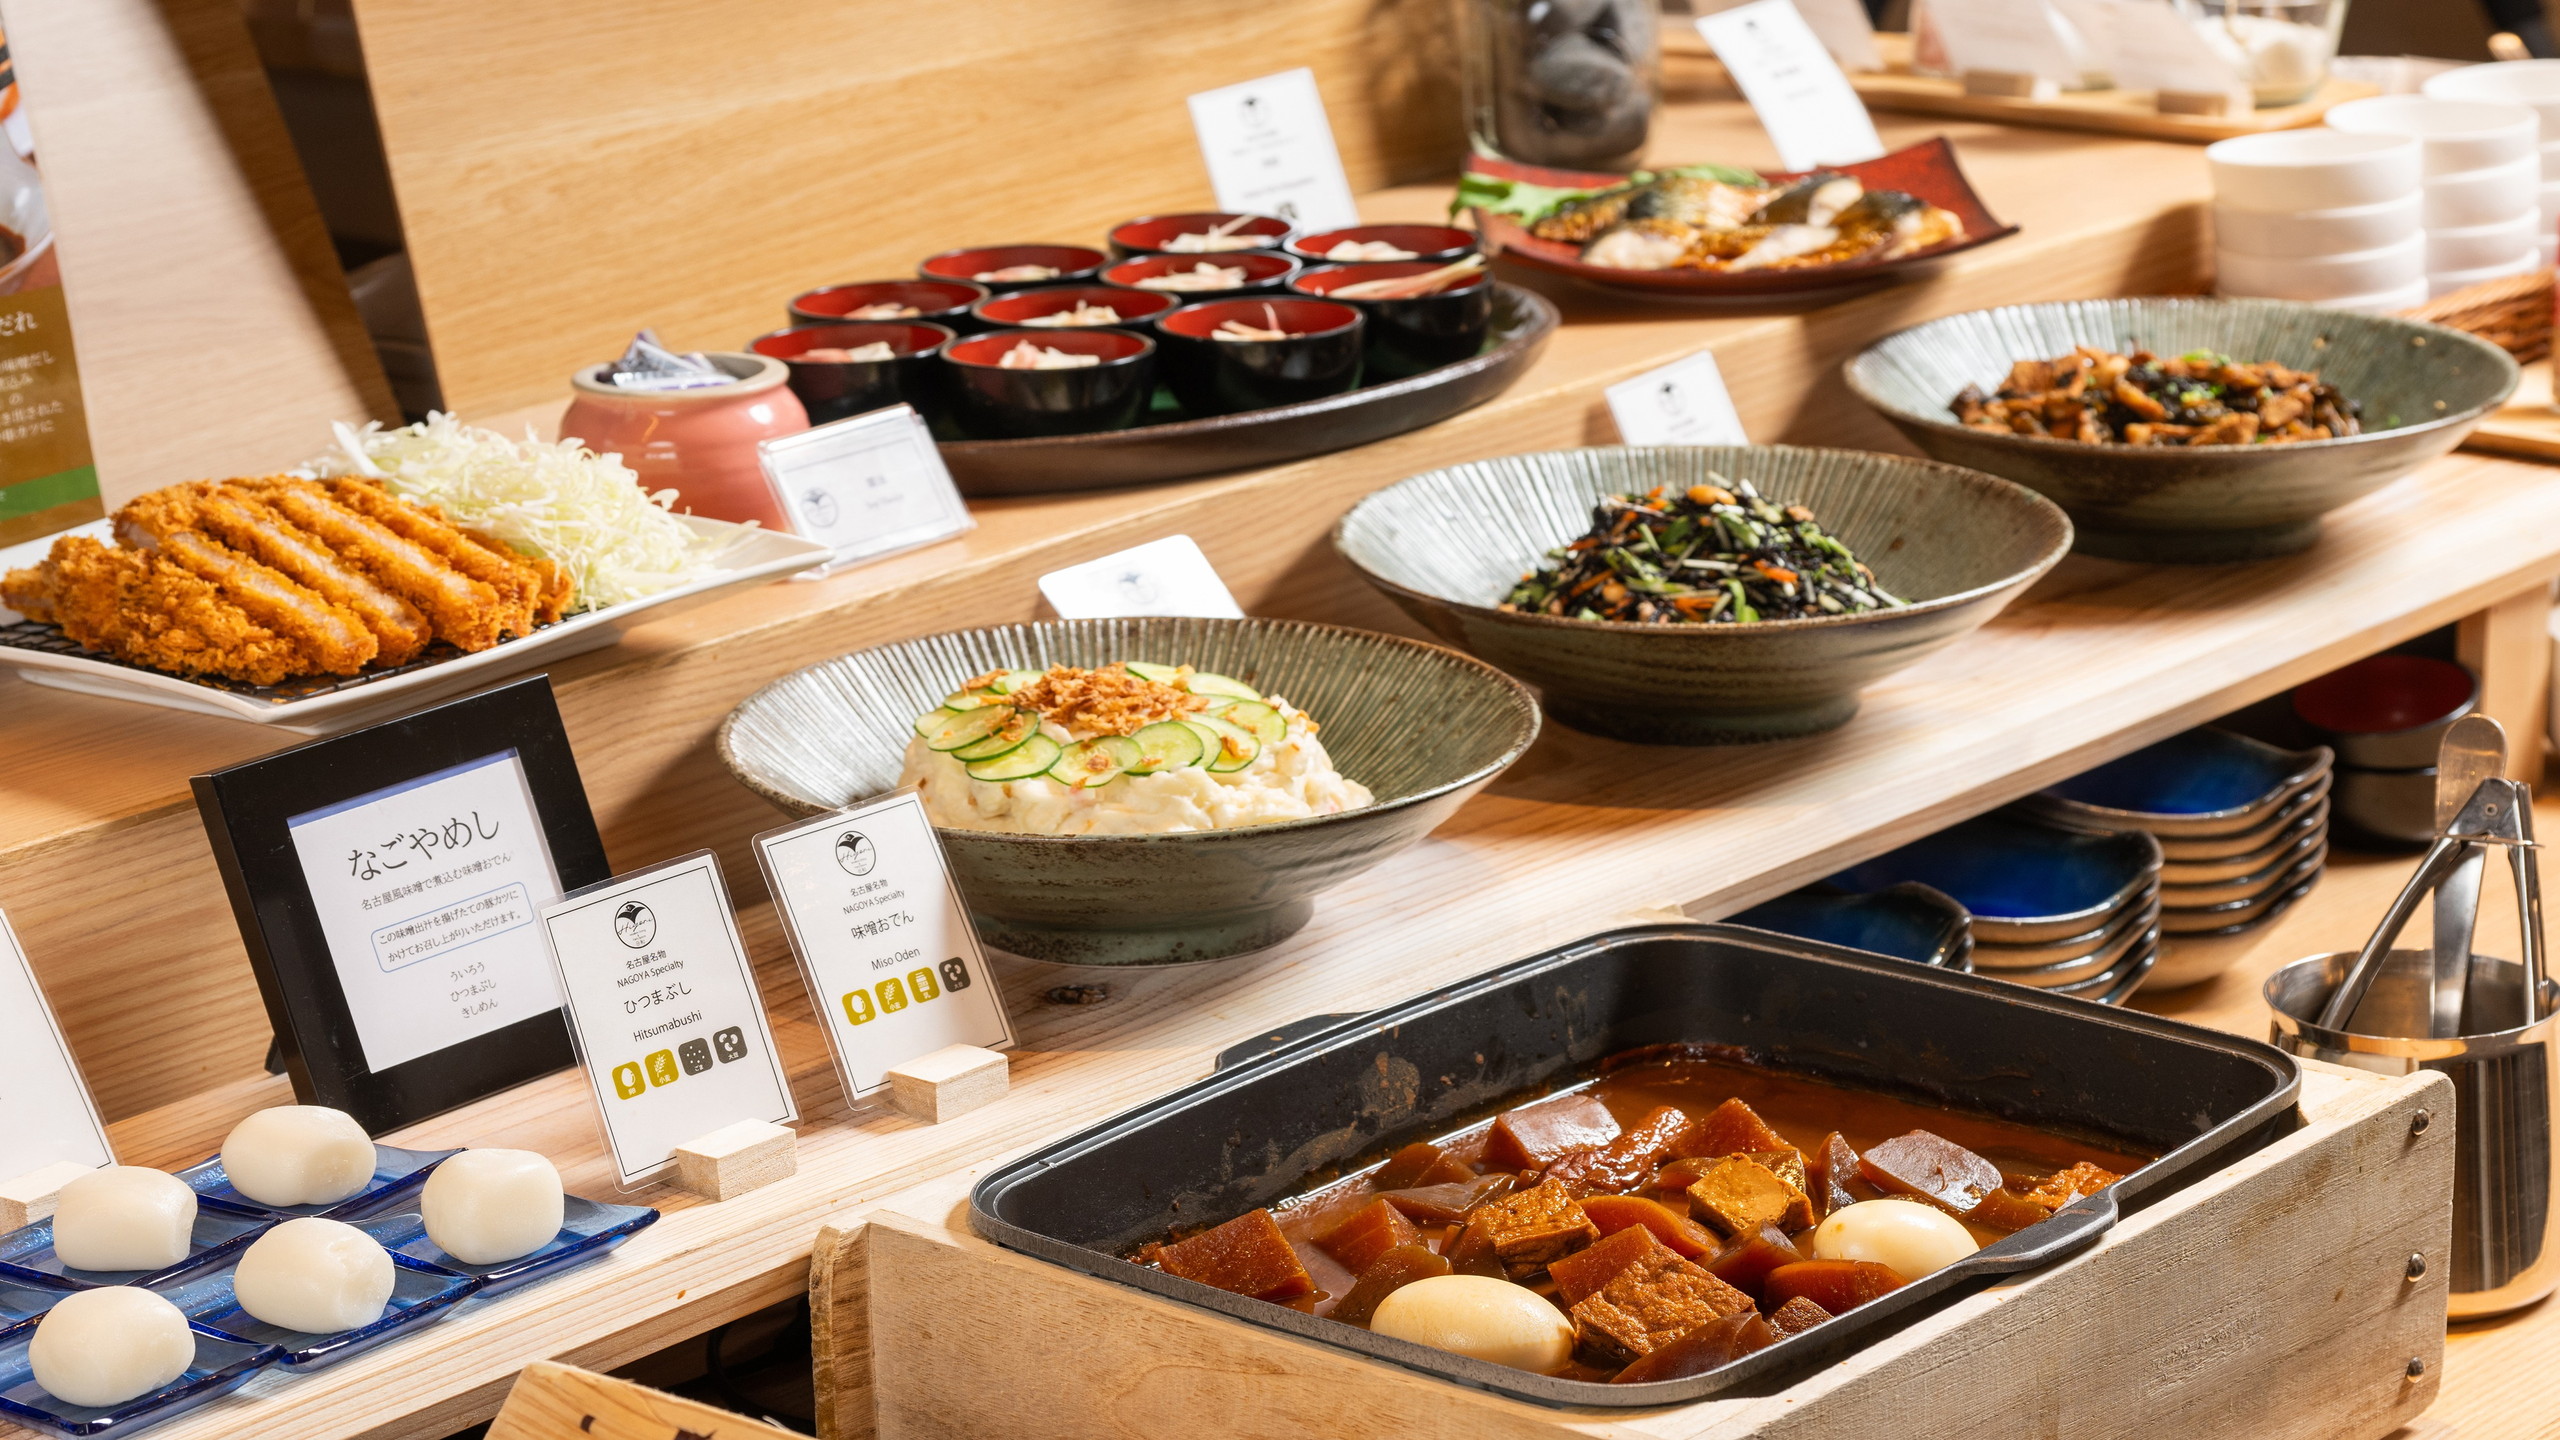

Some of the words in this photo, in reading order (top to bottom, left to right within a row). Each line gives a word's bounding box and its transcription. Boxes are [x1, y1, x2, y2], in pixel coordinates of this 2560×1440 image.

[348, 811, 499, 880] なごやめし
[361, 852, 512, 911] 名古屋風味噌で煮込む味噌おでん
[850, 878, 888, 897] 名古屋名物
[842, 898, 875, 915] NAGOYA
[874, 889, 905, 906] Specialty
[379, 890, 519, 944] この味噌出汁を揚げたての豚カツに
[850, 910, 914, 940] 味噌おでん
[388, 910, 521, 962] かけてお召し上がりいただけます。
[450, 962, 485, 981] ういろう
[626, 950, 667, 970] 名古屋名物
[871, 956, 894, 971] Miso
[894, 946, 920, 964] Oden
[617, 970, 650, 988] NAGOYA
[650, 960, 684, 977] Specialty
[450, 979, 497, 1002] ひつまぶし
[623, 982, 692, 1013] ひつまぶし
[462, 998, 498, 1018] きしめん
[633, 1009, 702, 1043] Hitsumabushi
